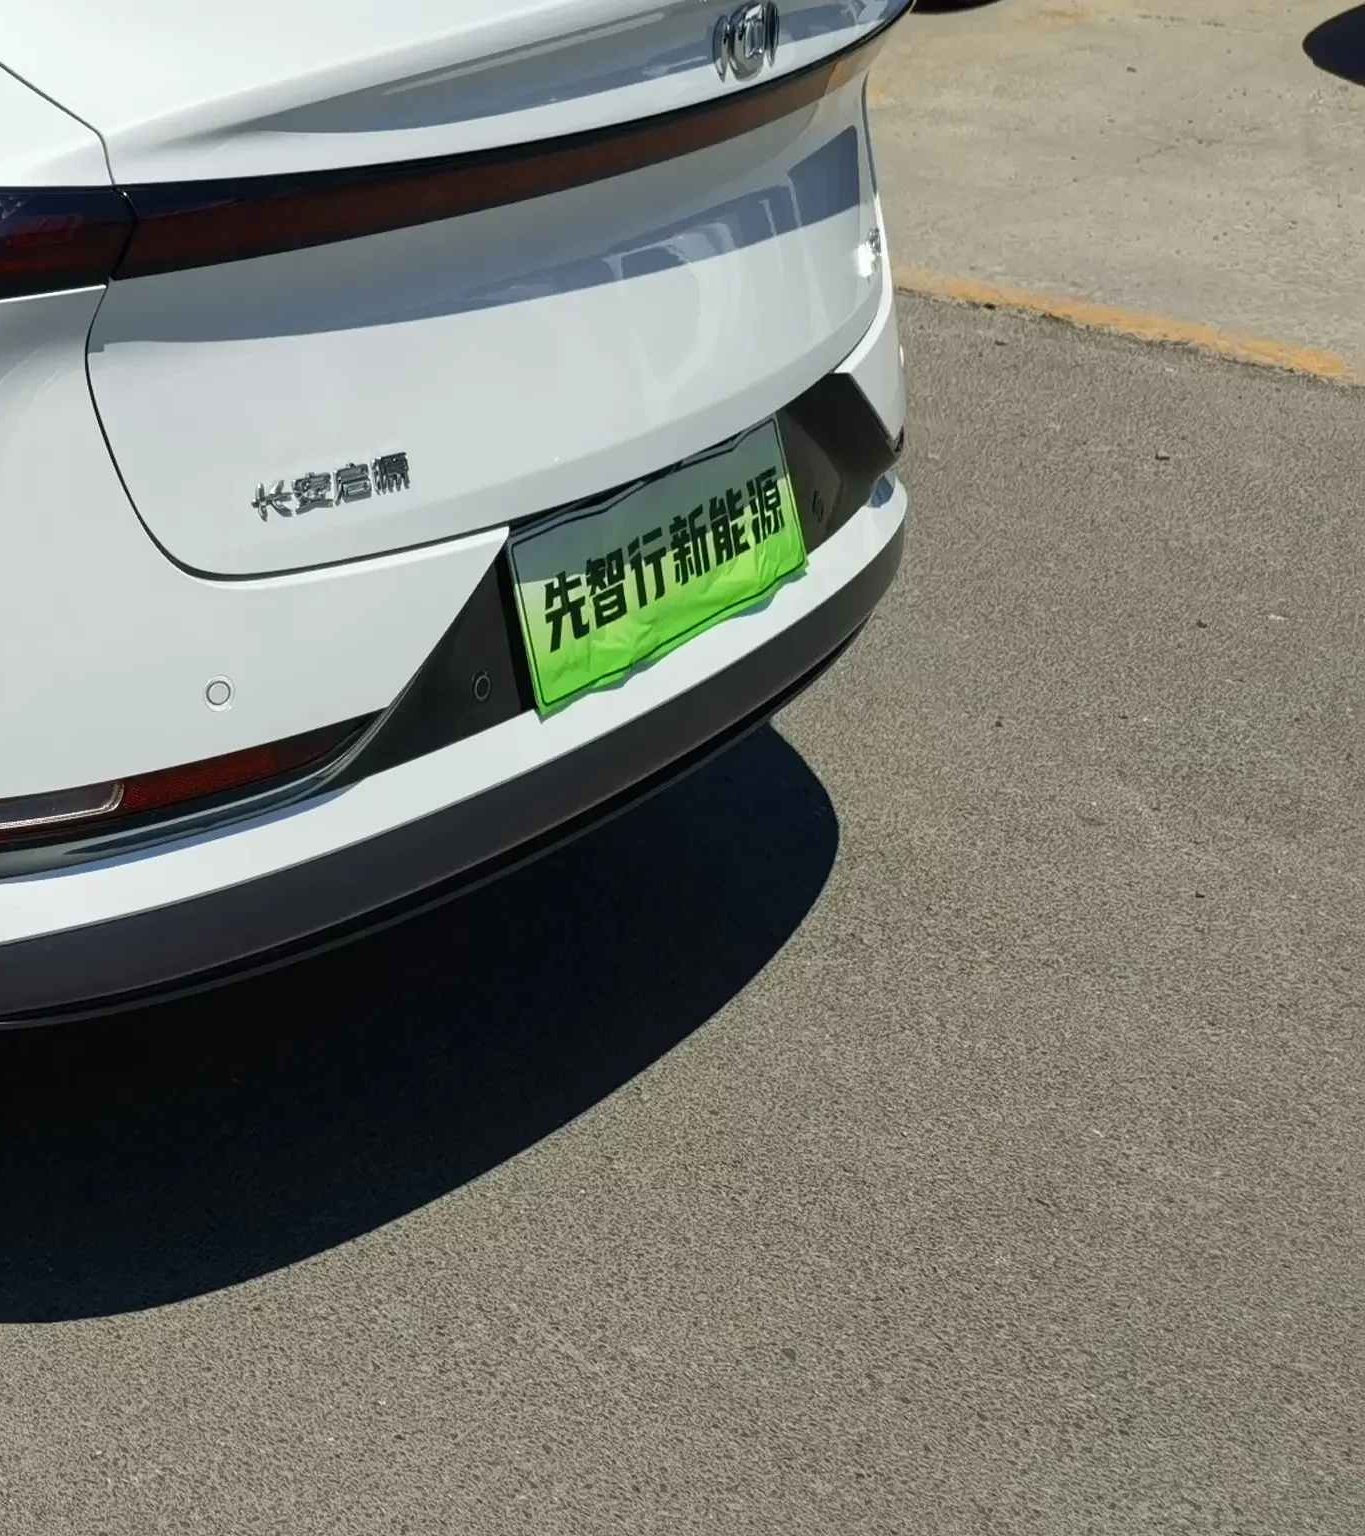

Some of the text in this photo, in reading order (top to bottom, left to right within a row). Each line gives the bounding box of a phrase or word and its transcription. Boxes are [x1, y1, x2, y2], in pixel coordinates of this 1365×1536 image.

[250, 451, 411, 522] 长安启源
[544, 465, 785, 653] 先智行新能源
